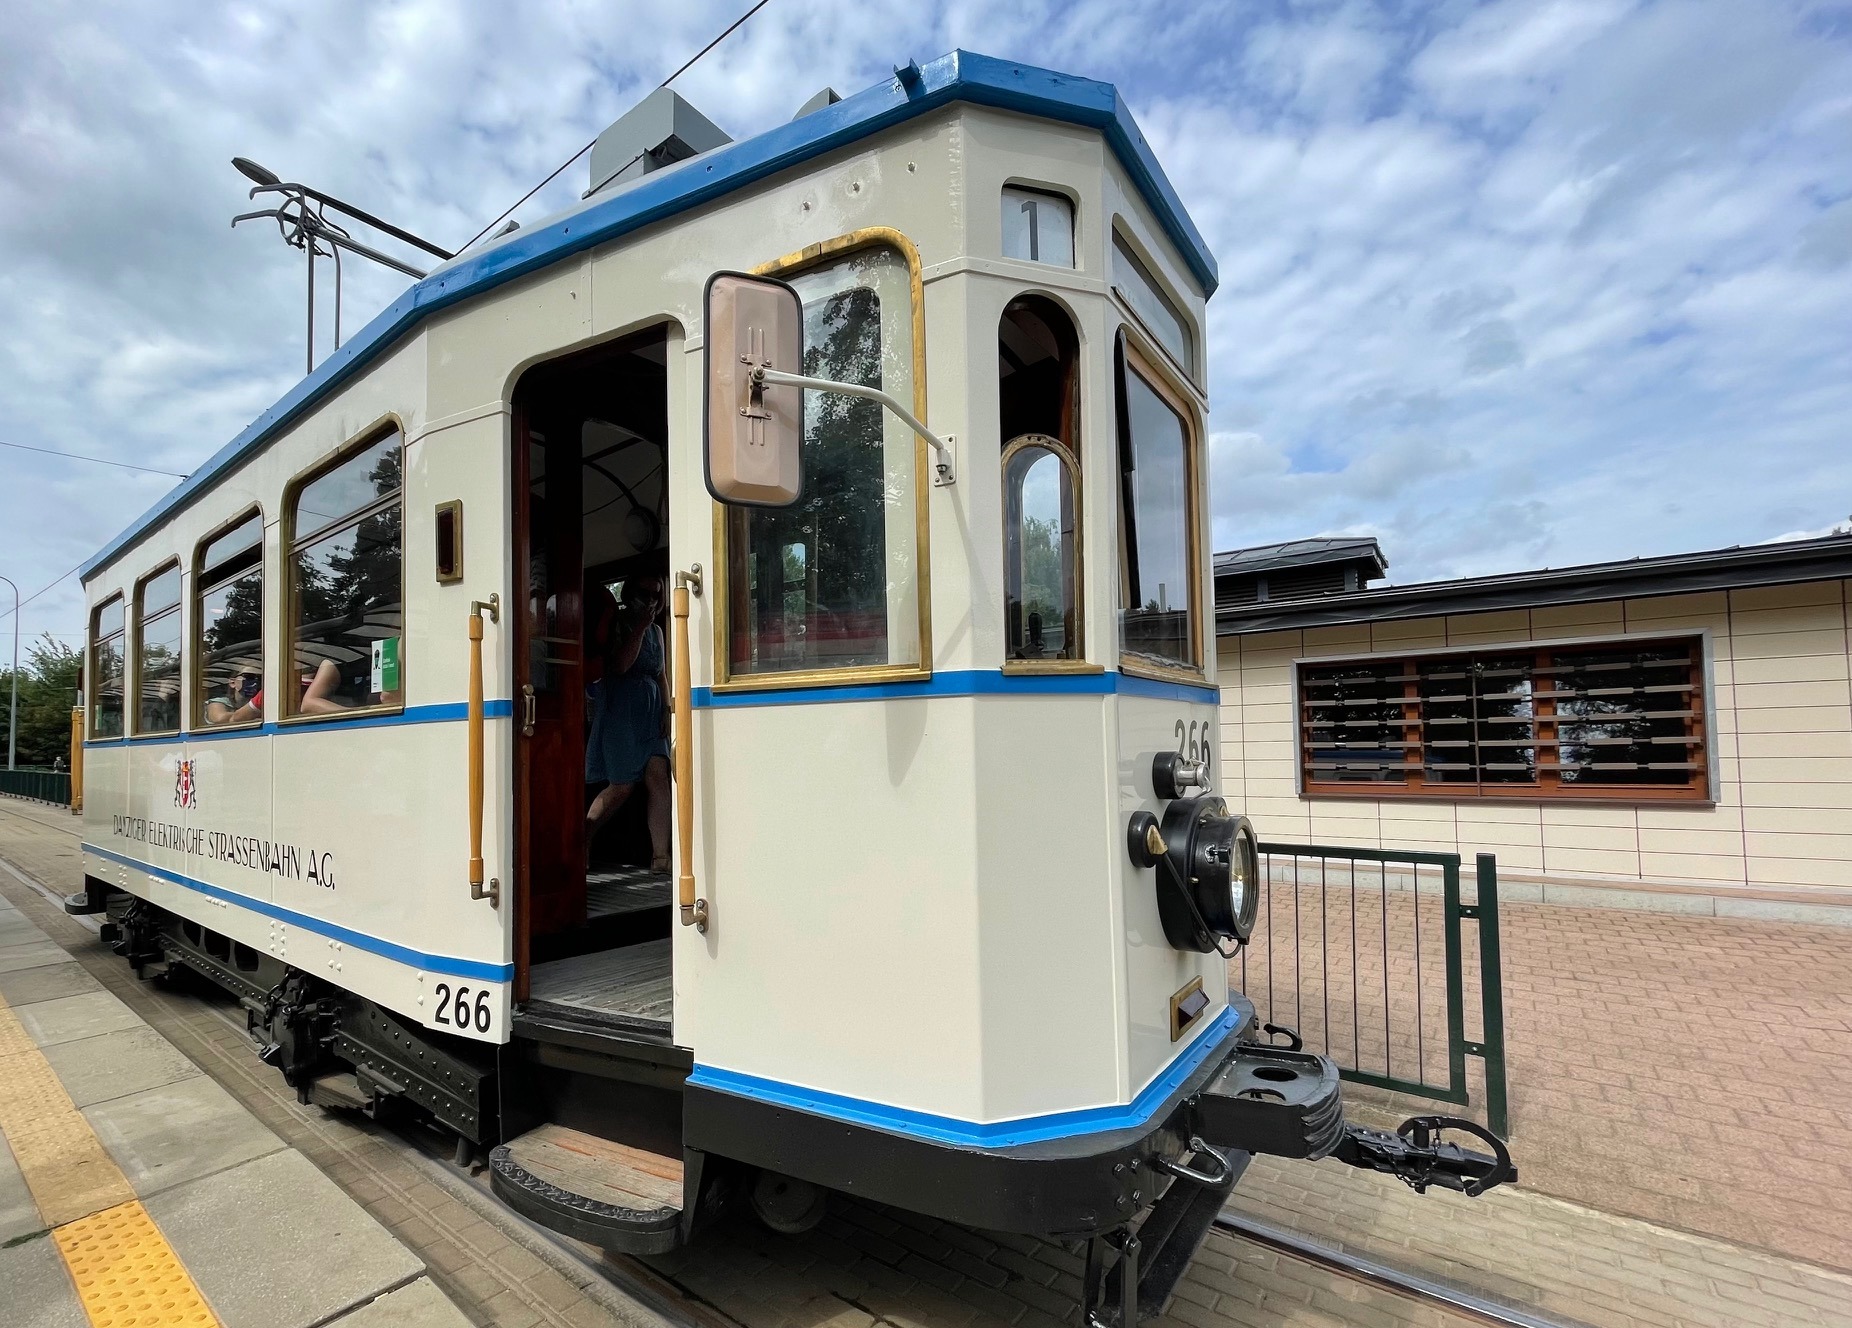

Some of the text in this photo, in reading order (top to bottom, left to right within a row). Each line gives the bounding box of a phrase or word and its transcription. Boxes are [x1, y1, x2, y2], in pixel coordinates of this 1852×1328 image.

[1021, 200, 1039, 261] 1
[1175, 718, 1211, 770] 266
[113, 814, 335, 890] DANZIGER ELEKTRISCHE STRASSENBAHN A.G.
[434, 982, 491, 1034] 266
